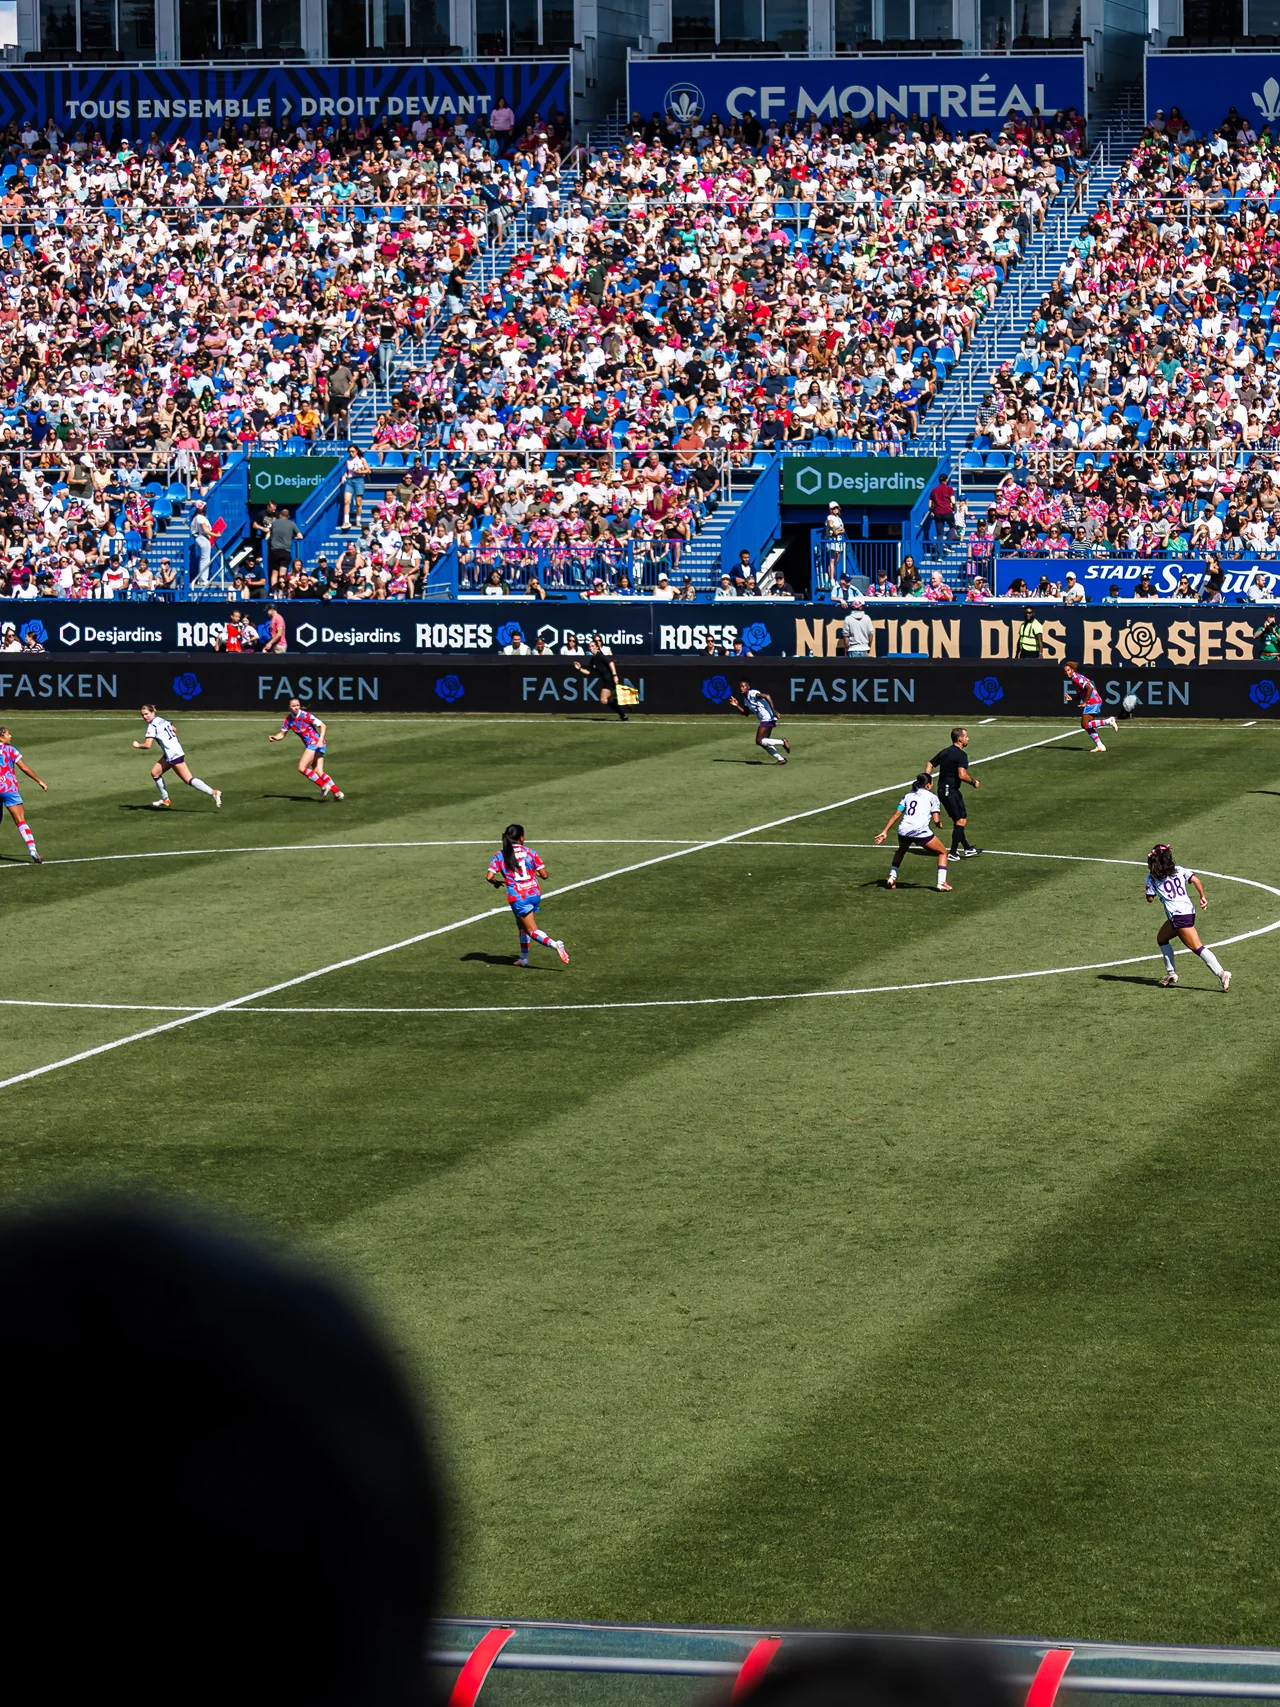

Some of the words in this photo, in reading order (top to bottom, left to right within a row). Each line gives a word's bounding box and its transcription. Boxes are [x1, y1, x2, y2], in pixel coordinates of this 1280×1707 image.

[66, 100, 131, 119] TOUS
[138, 98, 271, 118] ENSEMBLE
[302, 96, 380, 116] DROIT
[388, 95, 491, 116] DEVANT
[726, 86, 786, 119] CF
[797, 73, 1057, 118] MONTRÉAL
[828, 472, 925, 494] Desjardins
[84, 626, 162, 645] Desjardins
[321, 626, 401, 646] Desjardins
[416, 623, 493, 648] ROSES
[660, 625, 737, 650] ROSES
[0, 674, 117, 698] FASKEN
[258, 675, 379, 701] FASKEN
[522, 676, 645, 702] FASKN
[790, 678, 915, 703] FASKEN
[1063, 680, 1189, 706] FSKEN
[907, 800, 918, 816] 8
[1163, 877, 1186, 899] 98
